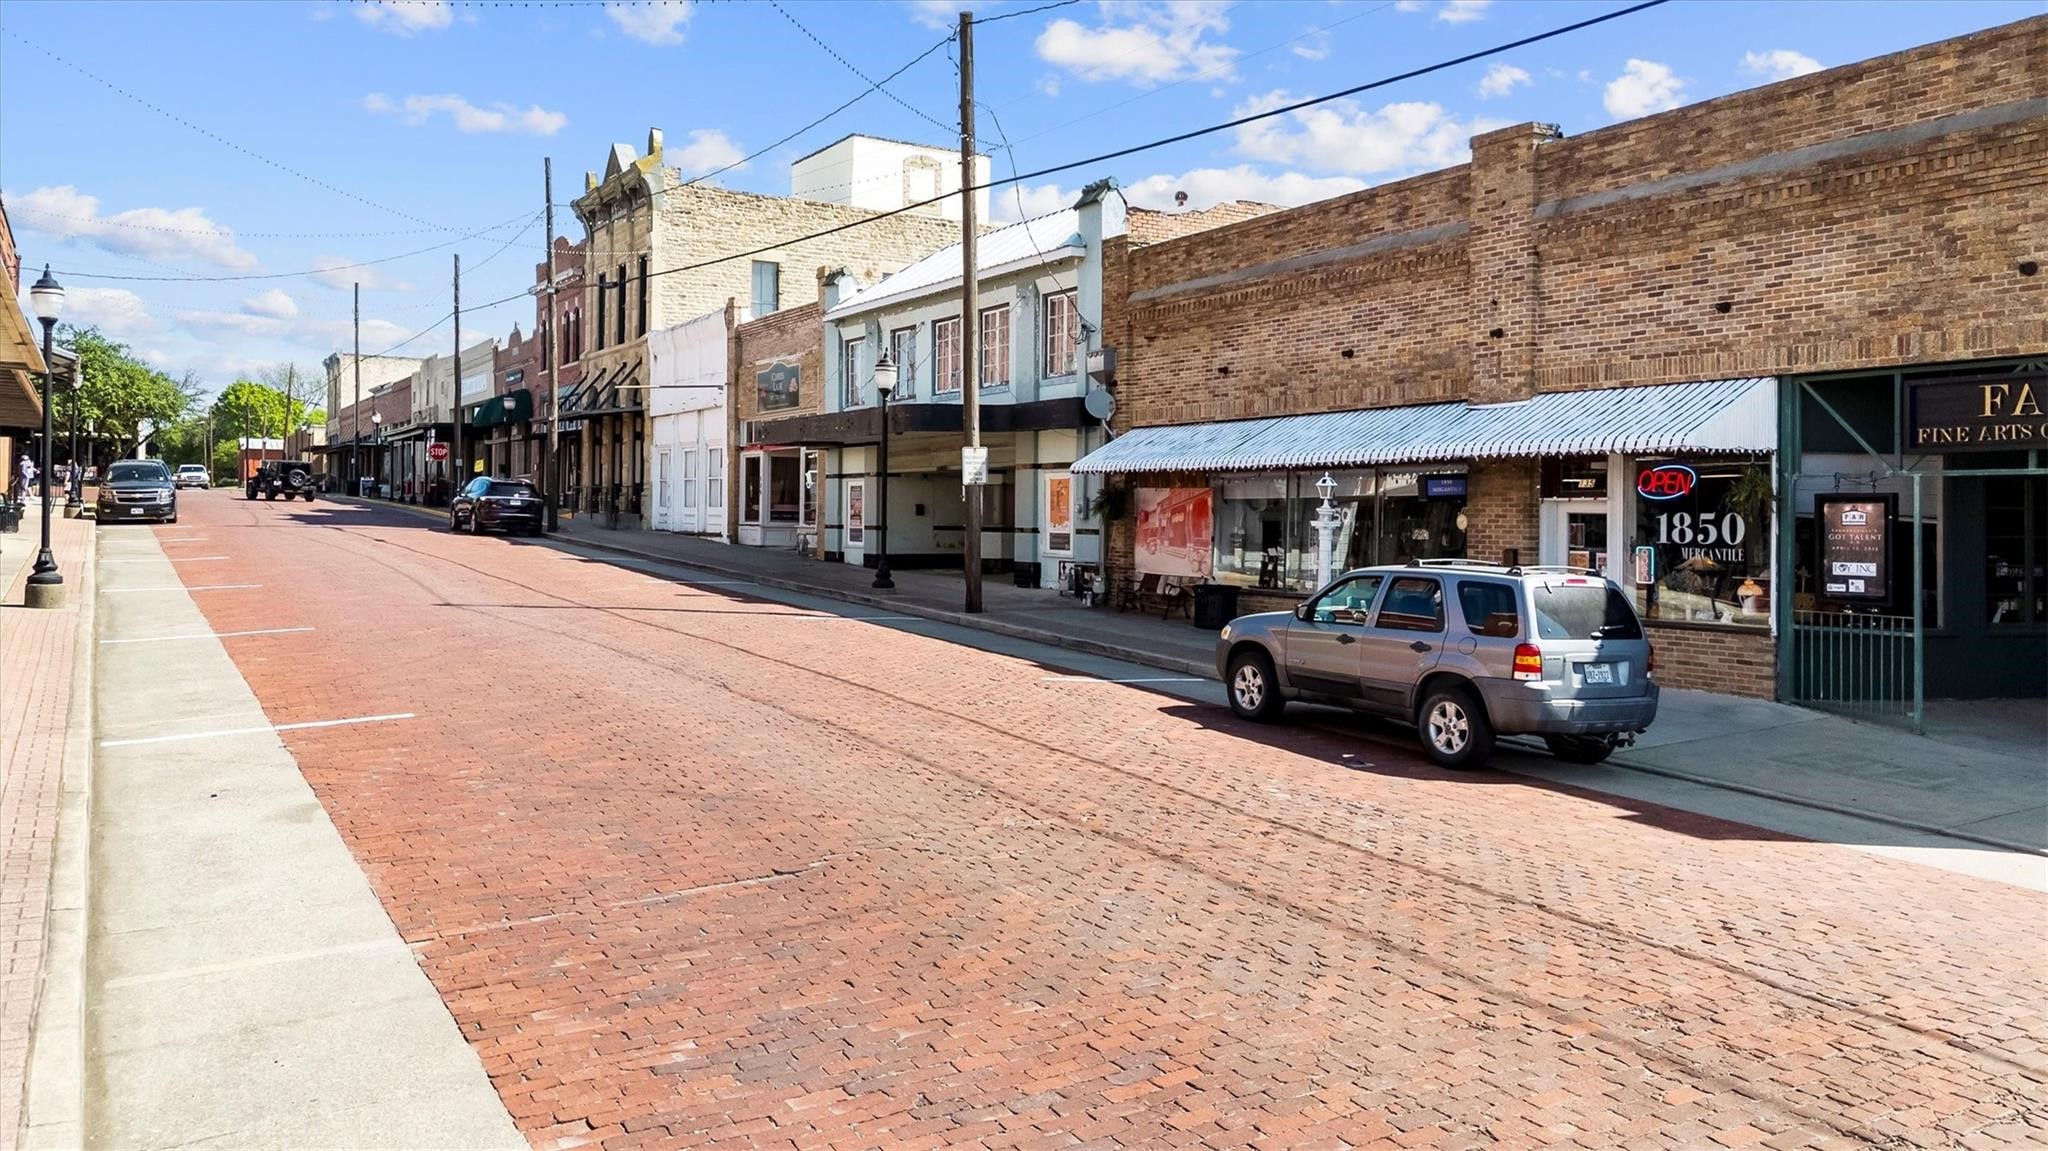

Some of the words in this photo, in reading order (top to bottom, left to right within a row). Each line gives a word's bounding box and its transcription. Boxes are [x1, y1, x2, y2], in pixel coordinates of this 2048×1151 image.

[1978, 383, 2044, 417] FA
[1918, 426, 1970, 444] FINE
[1978, 423, 2032, 441] ARTS
[430, 447, 448, 456] STOP
[1639, 470, 1692, 496] OPEN
[1656, 512, 1745, 545] 1850
[1850, 533, 1882, 541] TALENT
[1681, 547, 1744, 562] MERCANTILE
